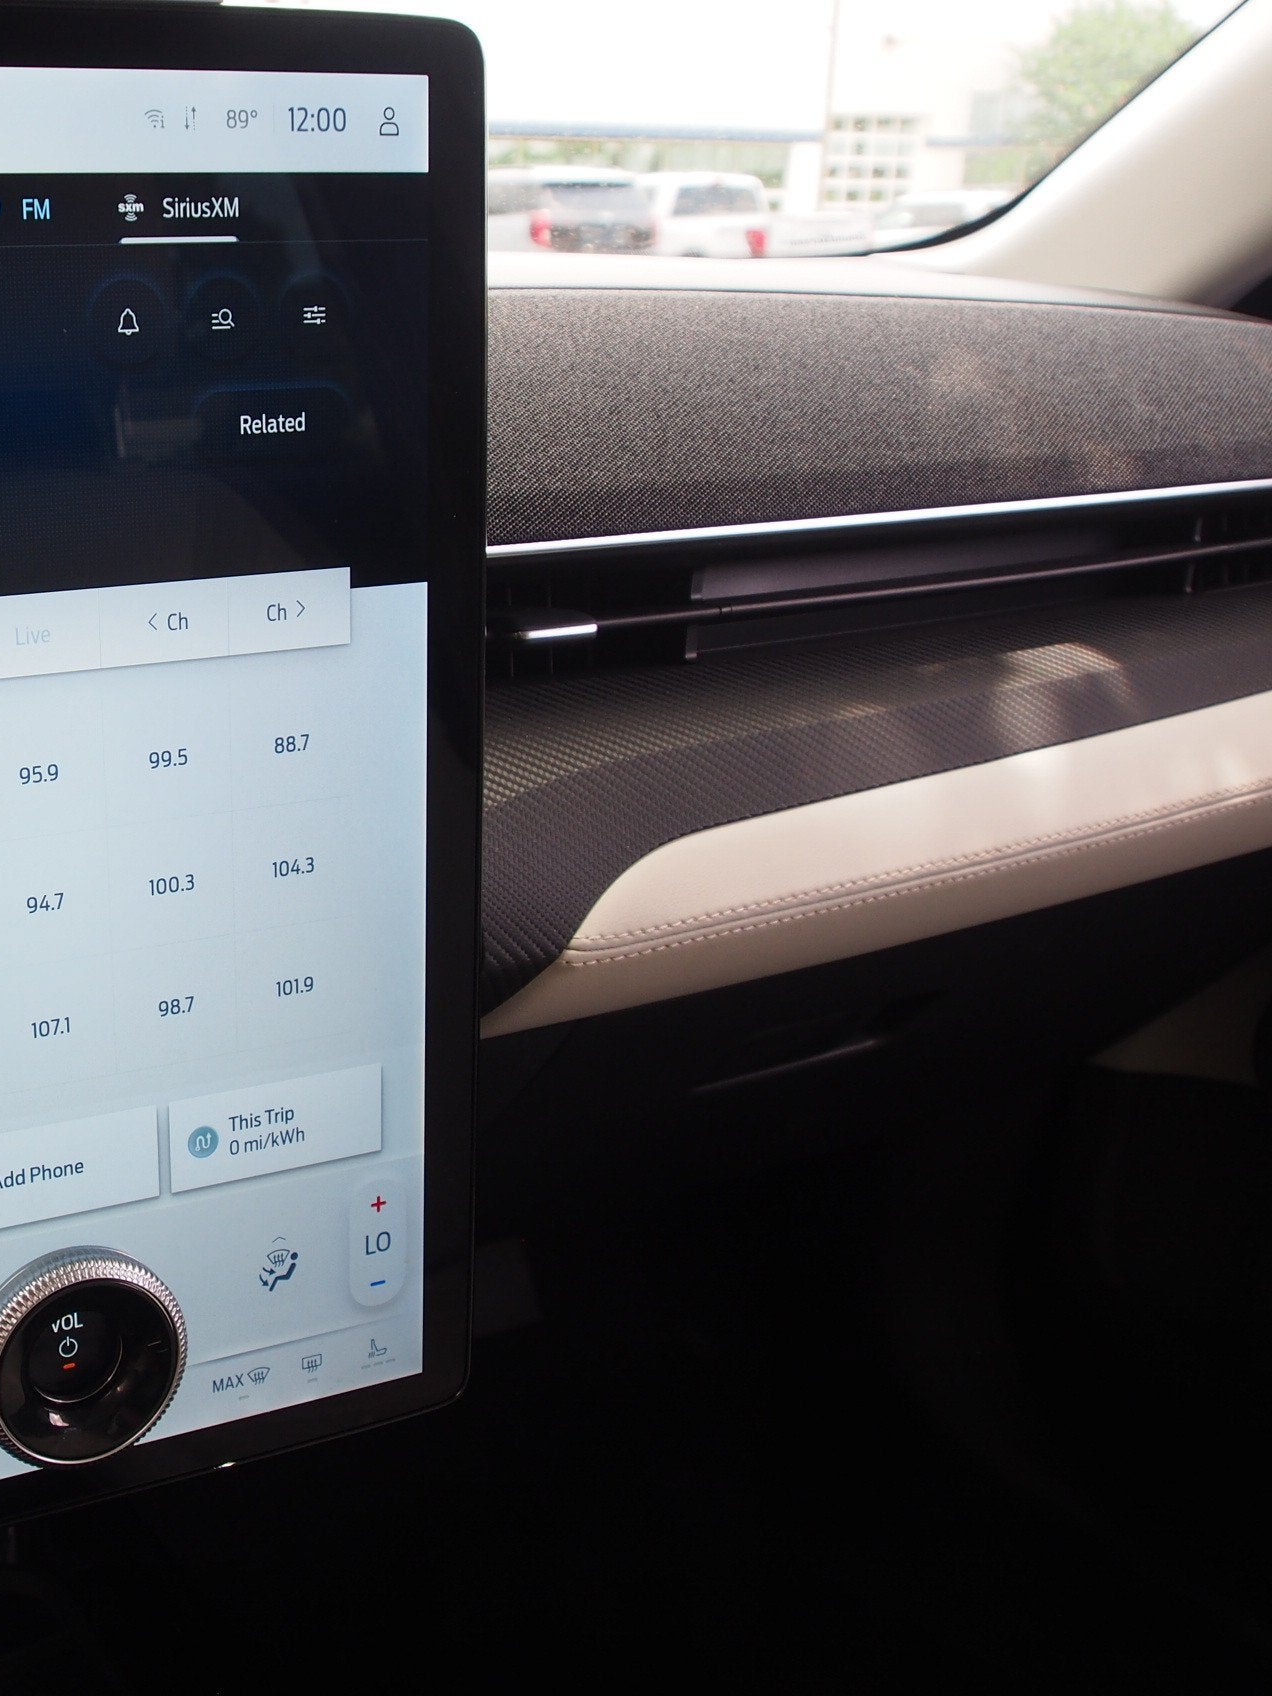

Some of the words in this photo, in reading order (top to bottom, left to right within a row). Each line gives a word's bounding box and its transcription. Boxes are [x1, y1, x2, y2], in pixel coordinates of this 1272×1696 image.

[288, 106, 347, 132] 12:00
[22, 198, 51, 220] FM
[162, 197, 240, 219] SiriusXM
[239, 412, 306, 435] Related
[166, 612, 189, 632] Ch
[266, 602, 288, 622] Ch
[15, 626, 52, 646] Live
[273, 734, 310, 754] 88.7
[148, 748, 189, 769] 99.5
[19, 763, 60, 785] 95.9
[271, 856, 316, 878] 104.3
[148, 874, 196, 896] 100.3
[26, 892, 65, 914] 94.7
[275, 976, 315, 997] 101.9
[158, 996, 195, 1017] 98.7
[30, 1016, 72, 1039] 107.1
[229, 1113, 262, 1132] This
[264, 1106, 296, 1127] Trip
[229, 1138, 240, 1156] 0
[243, 1127, 306, 1153] mi/kWh
[29, 1159, 85, 1184] Phone
[365, 1231, 392, 1256] LO
[212, 1372, 245, 1394] MAX
